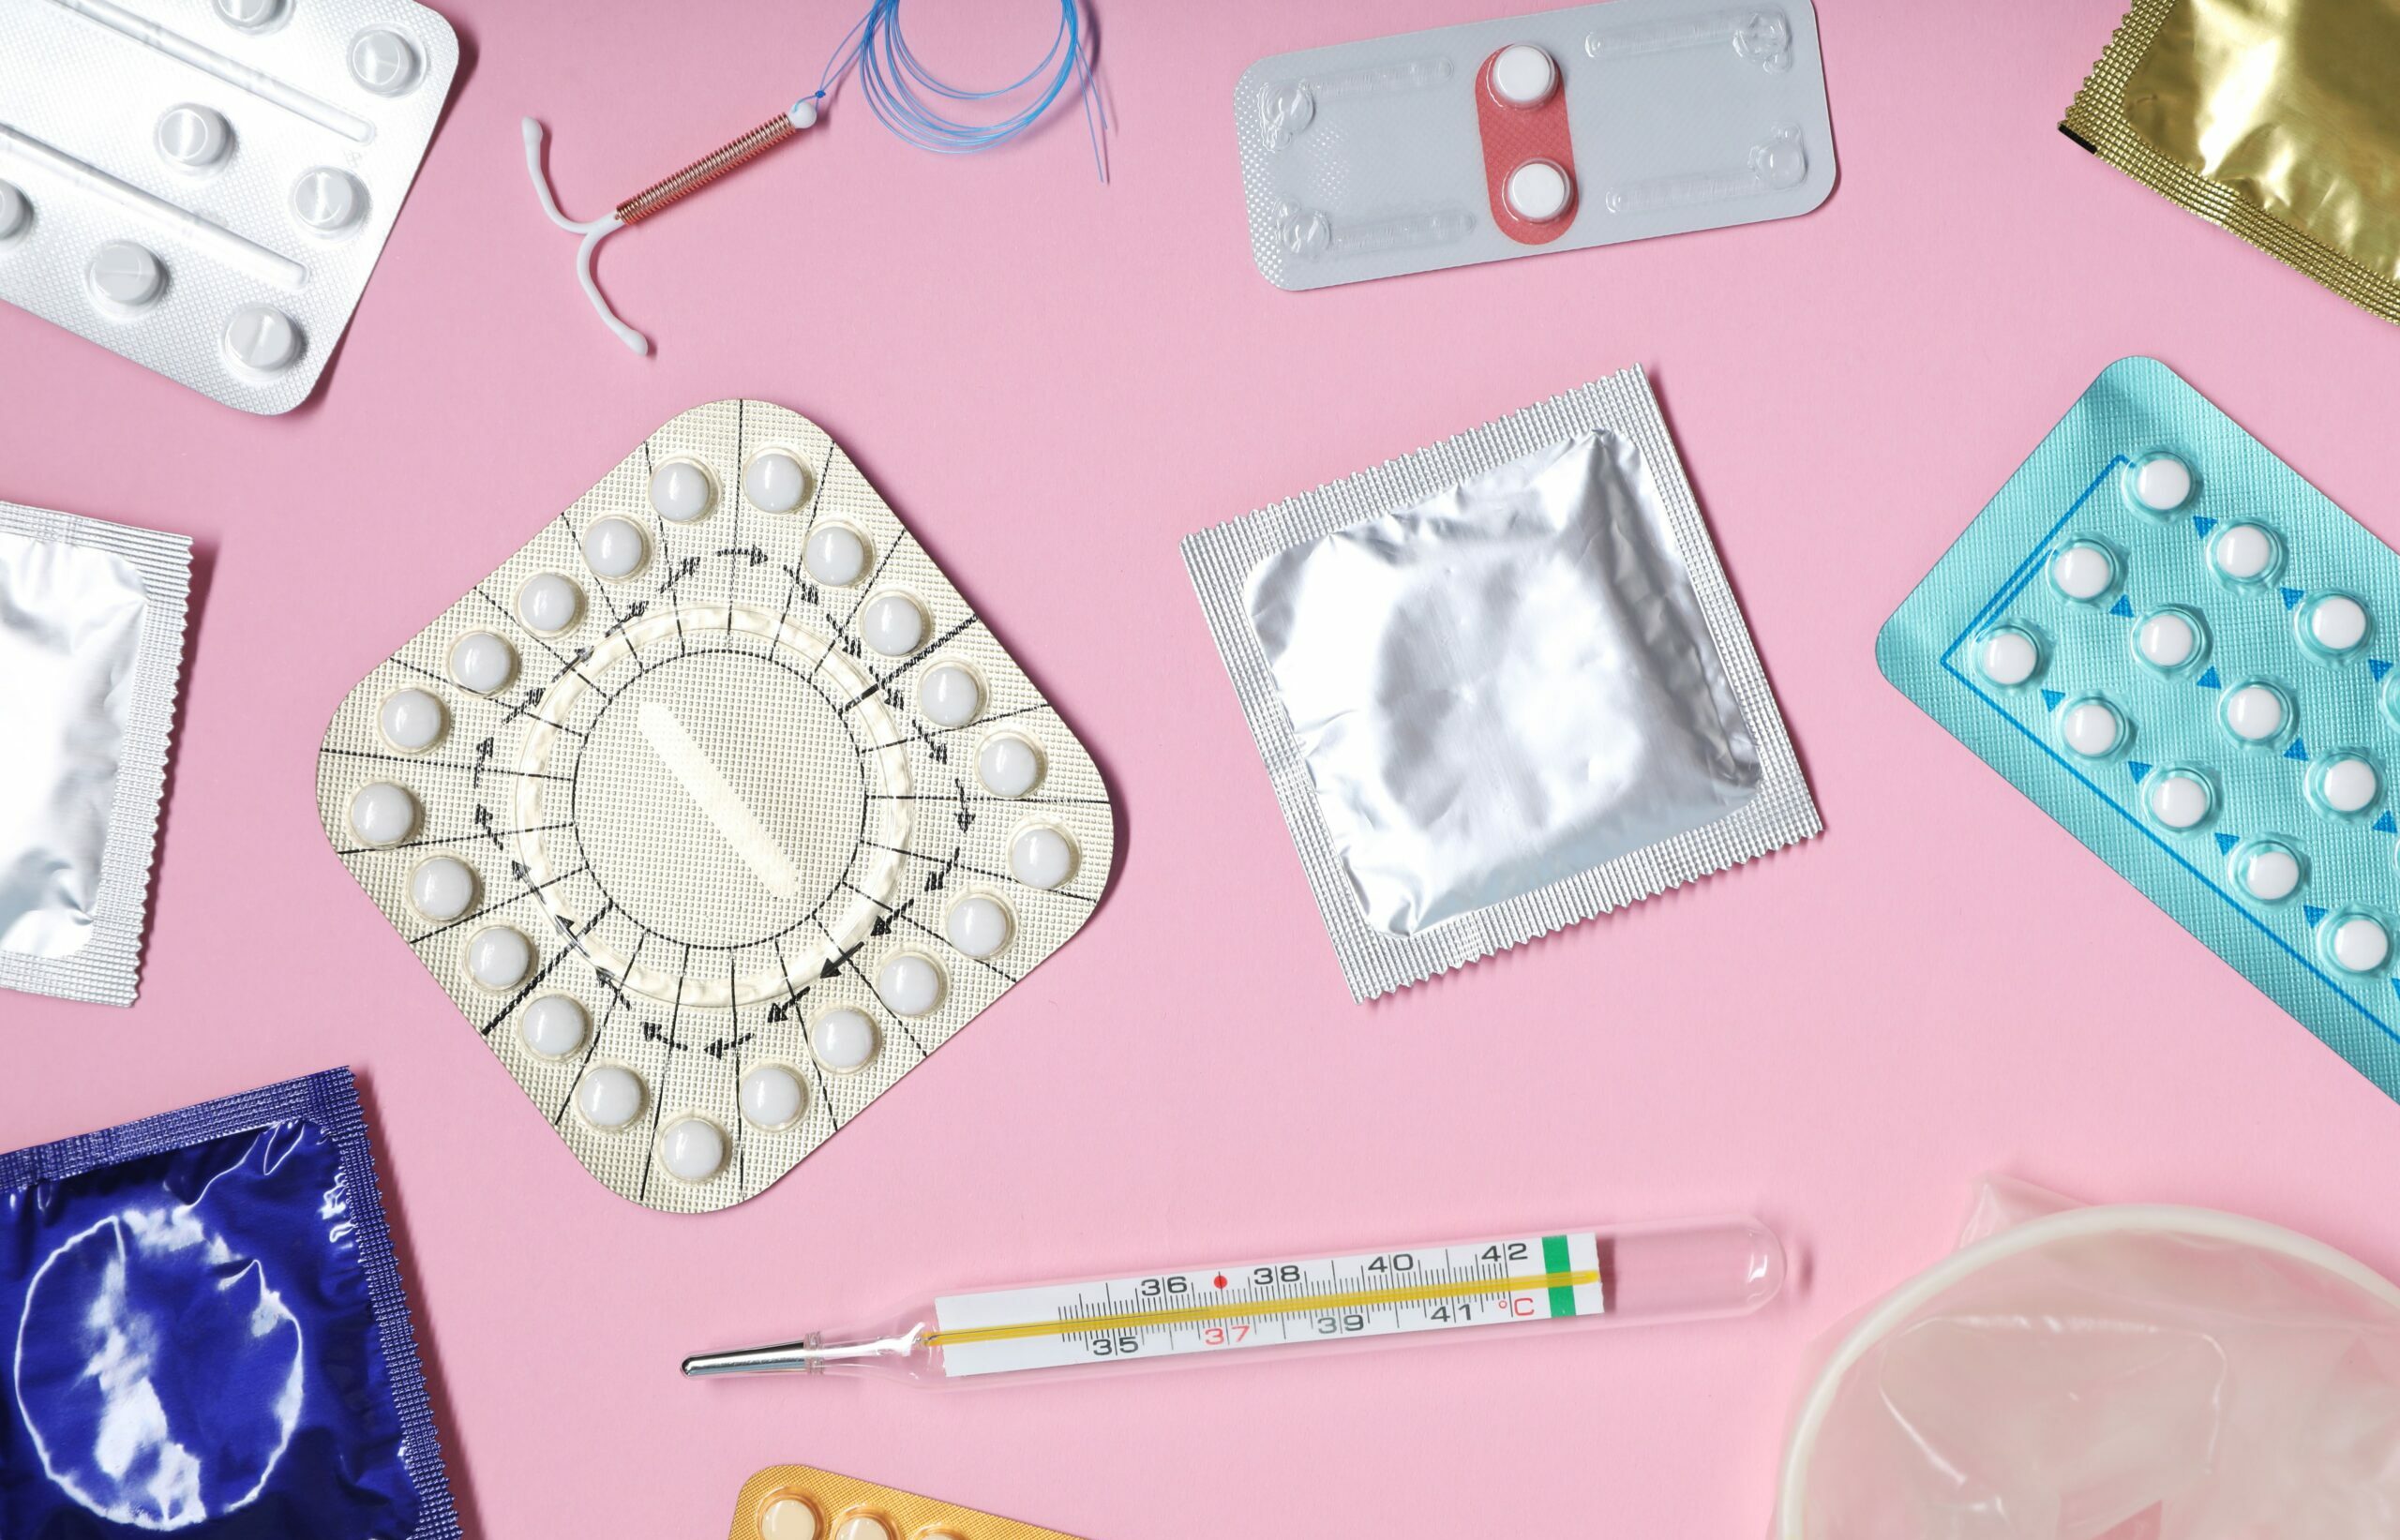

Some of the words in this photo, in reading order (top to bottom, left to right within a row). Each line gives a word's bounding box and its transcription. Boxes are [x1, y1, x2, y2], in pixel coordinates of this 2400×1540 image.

[1141, 1276, 1188, 1296] 36
[1253, 1265, 1301, 1286] 38
[1368, 1253, 1414, 1273] 40
[1481, 1242, 1529, 1263] 42
[1092, 1336, 1139, 1356] 35
[1205, 1325, 1251, 1346] 37
[1317, 1314, 1365, 1335] 39
[1431, 1304, 1475, 1323] 41
